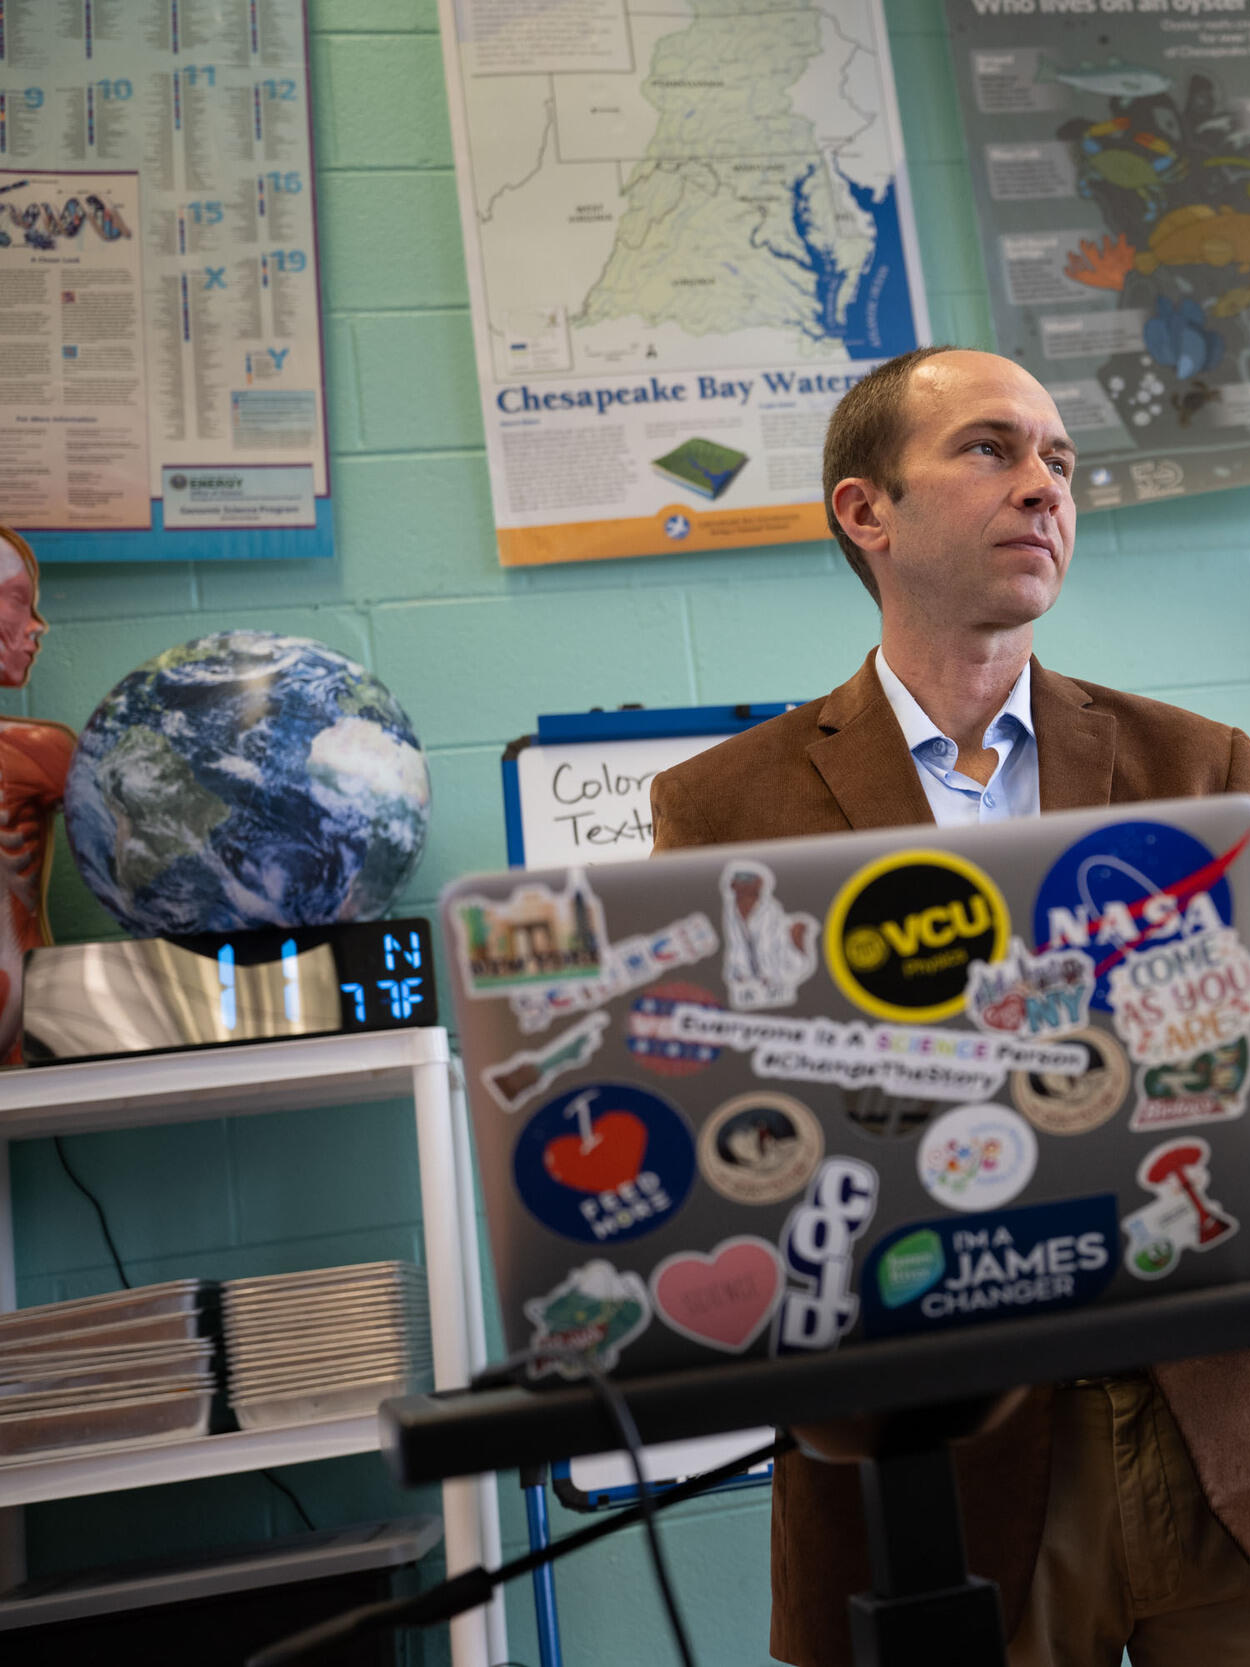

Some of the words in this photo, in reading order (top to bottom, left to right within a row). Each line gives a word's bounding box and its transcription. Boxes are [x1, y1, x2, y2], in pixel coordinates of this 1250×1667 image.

[97, 77, 134, 101] 10
[183, 64, 217, 87] 11
[263, 78, 297, 102] 12
[24, 86, 45, 110] 9
[267, 170, 303, 195] 16
[188, 200, 225, 226] 15
[204, 266, 227, 291] X
[270, 249, 307, 273] 19
[267, 347, 289, 370] Y
[496, 376, 688, 414] Chesapeake
[697, 374, 754, 405] Bay
[762, 368, 872, 396] Water
[552, 762, 664, 804] Color
[553, 808, 652, 846] Text
[880, 893, 992, 958] VCU
[1047, 891, 1226, 949] NASA
[1130, 942, 1219, 990] COME
[1122, 992, 1164, 1031] AS
[1164, 1008, 1230, 1051] ARE
[680, 1012, 805, 1047] Everyone
[875, 1030, 990, 1062] SCIENCE
[990, 1226, 1015, 1247] A
[944, 1232, 1110, 1292] JAMES
[920, 1273, 1076, 1320] CHANGER
